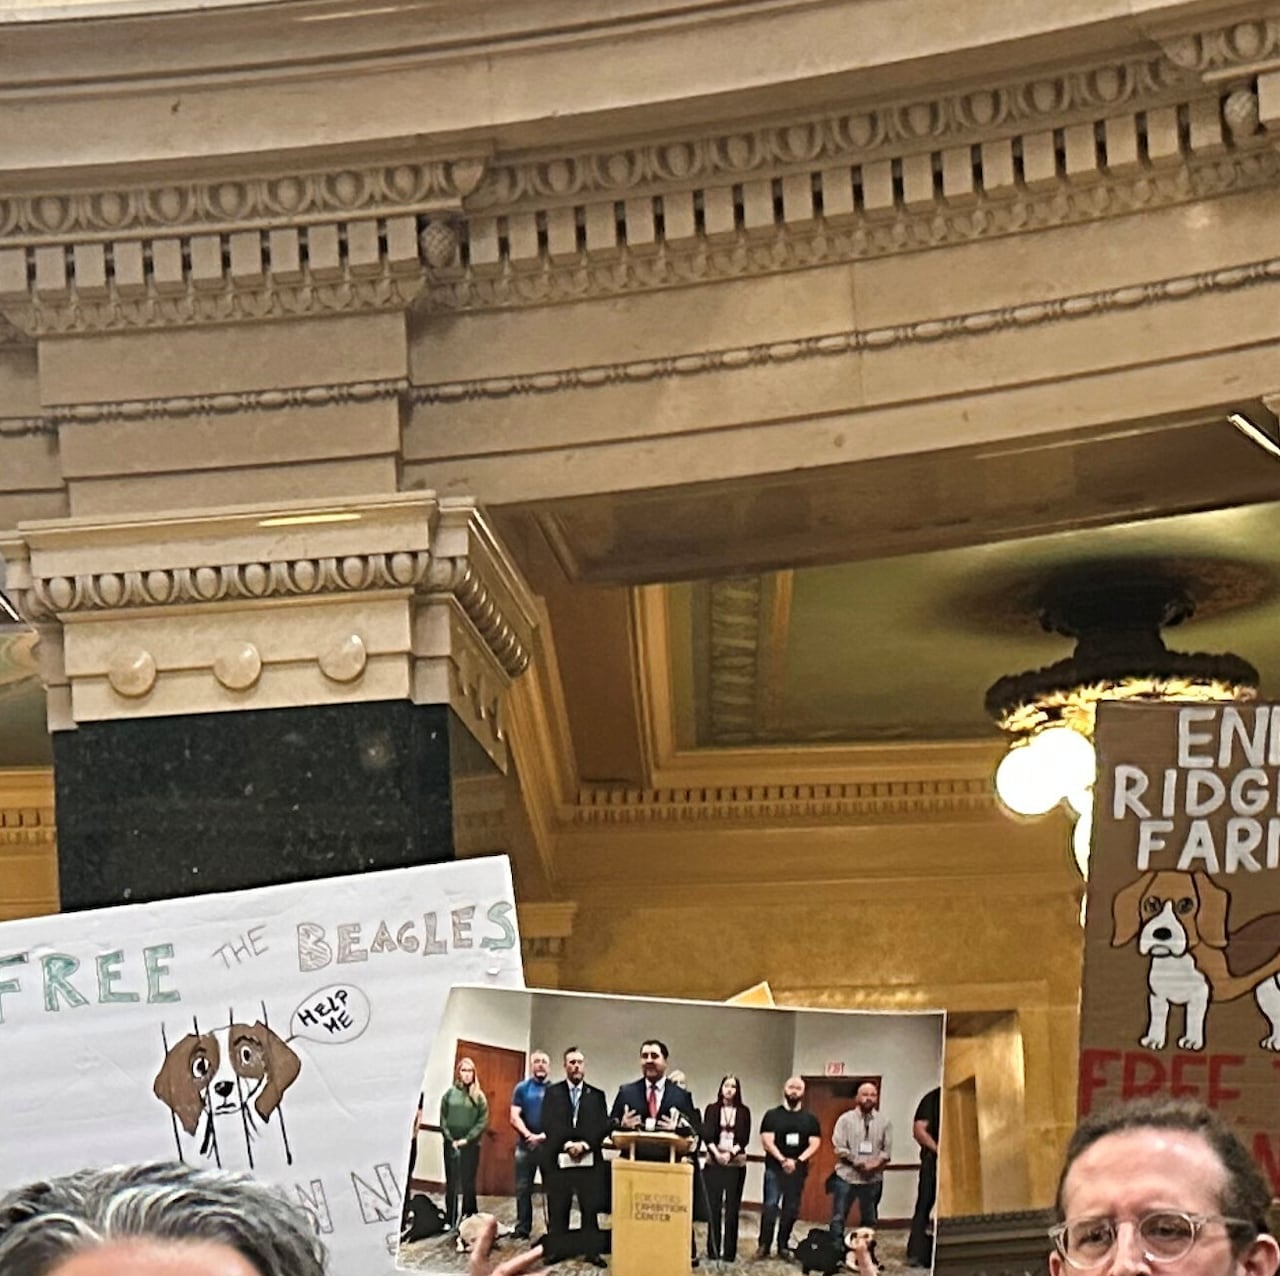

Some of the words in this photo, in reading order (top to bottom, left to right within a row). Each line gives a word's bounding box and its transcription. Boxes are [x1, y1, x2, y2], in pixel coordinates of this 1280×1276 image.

[211, 923, 270, 970] THE
[296, 901, 516, 972] BEAGLES
[296, 988, 349, 1028] HELP
[322, 1009, 355, 1034] ME
